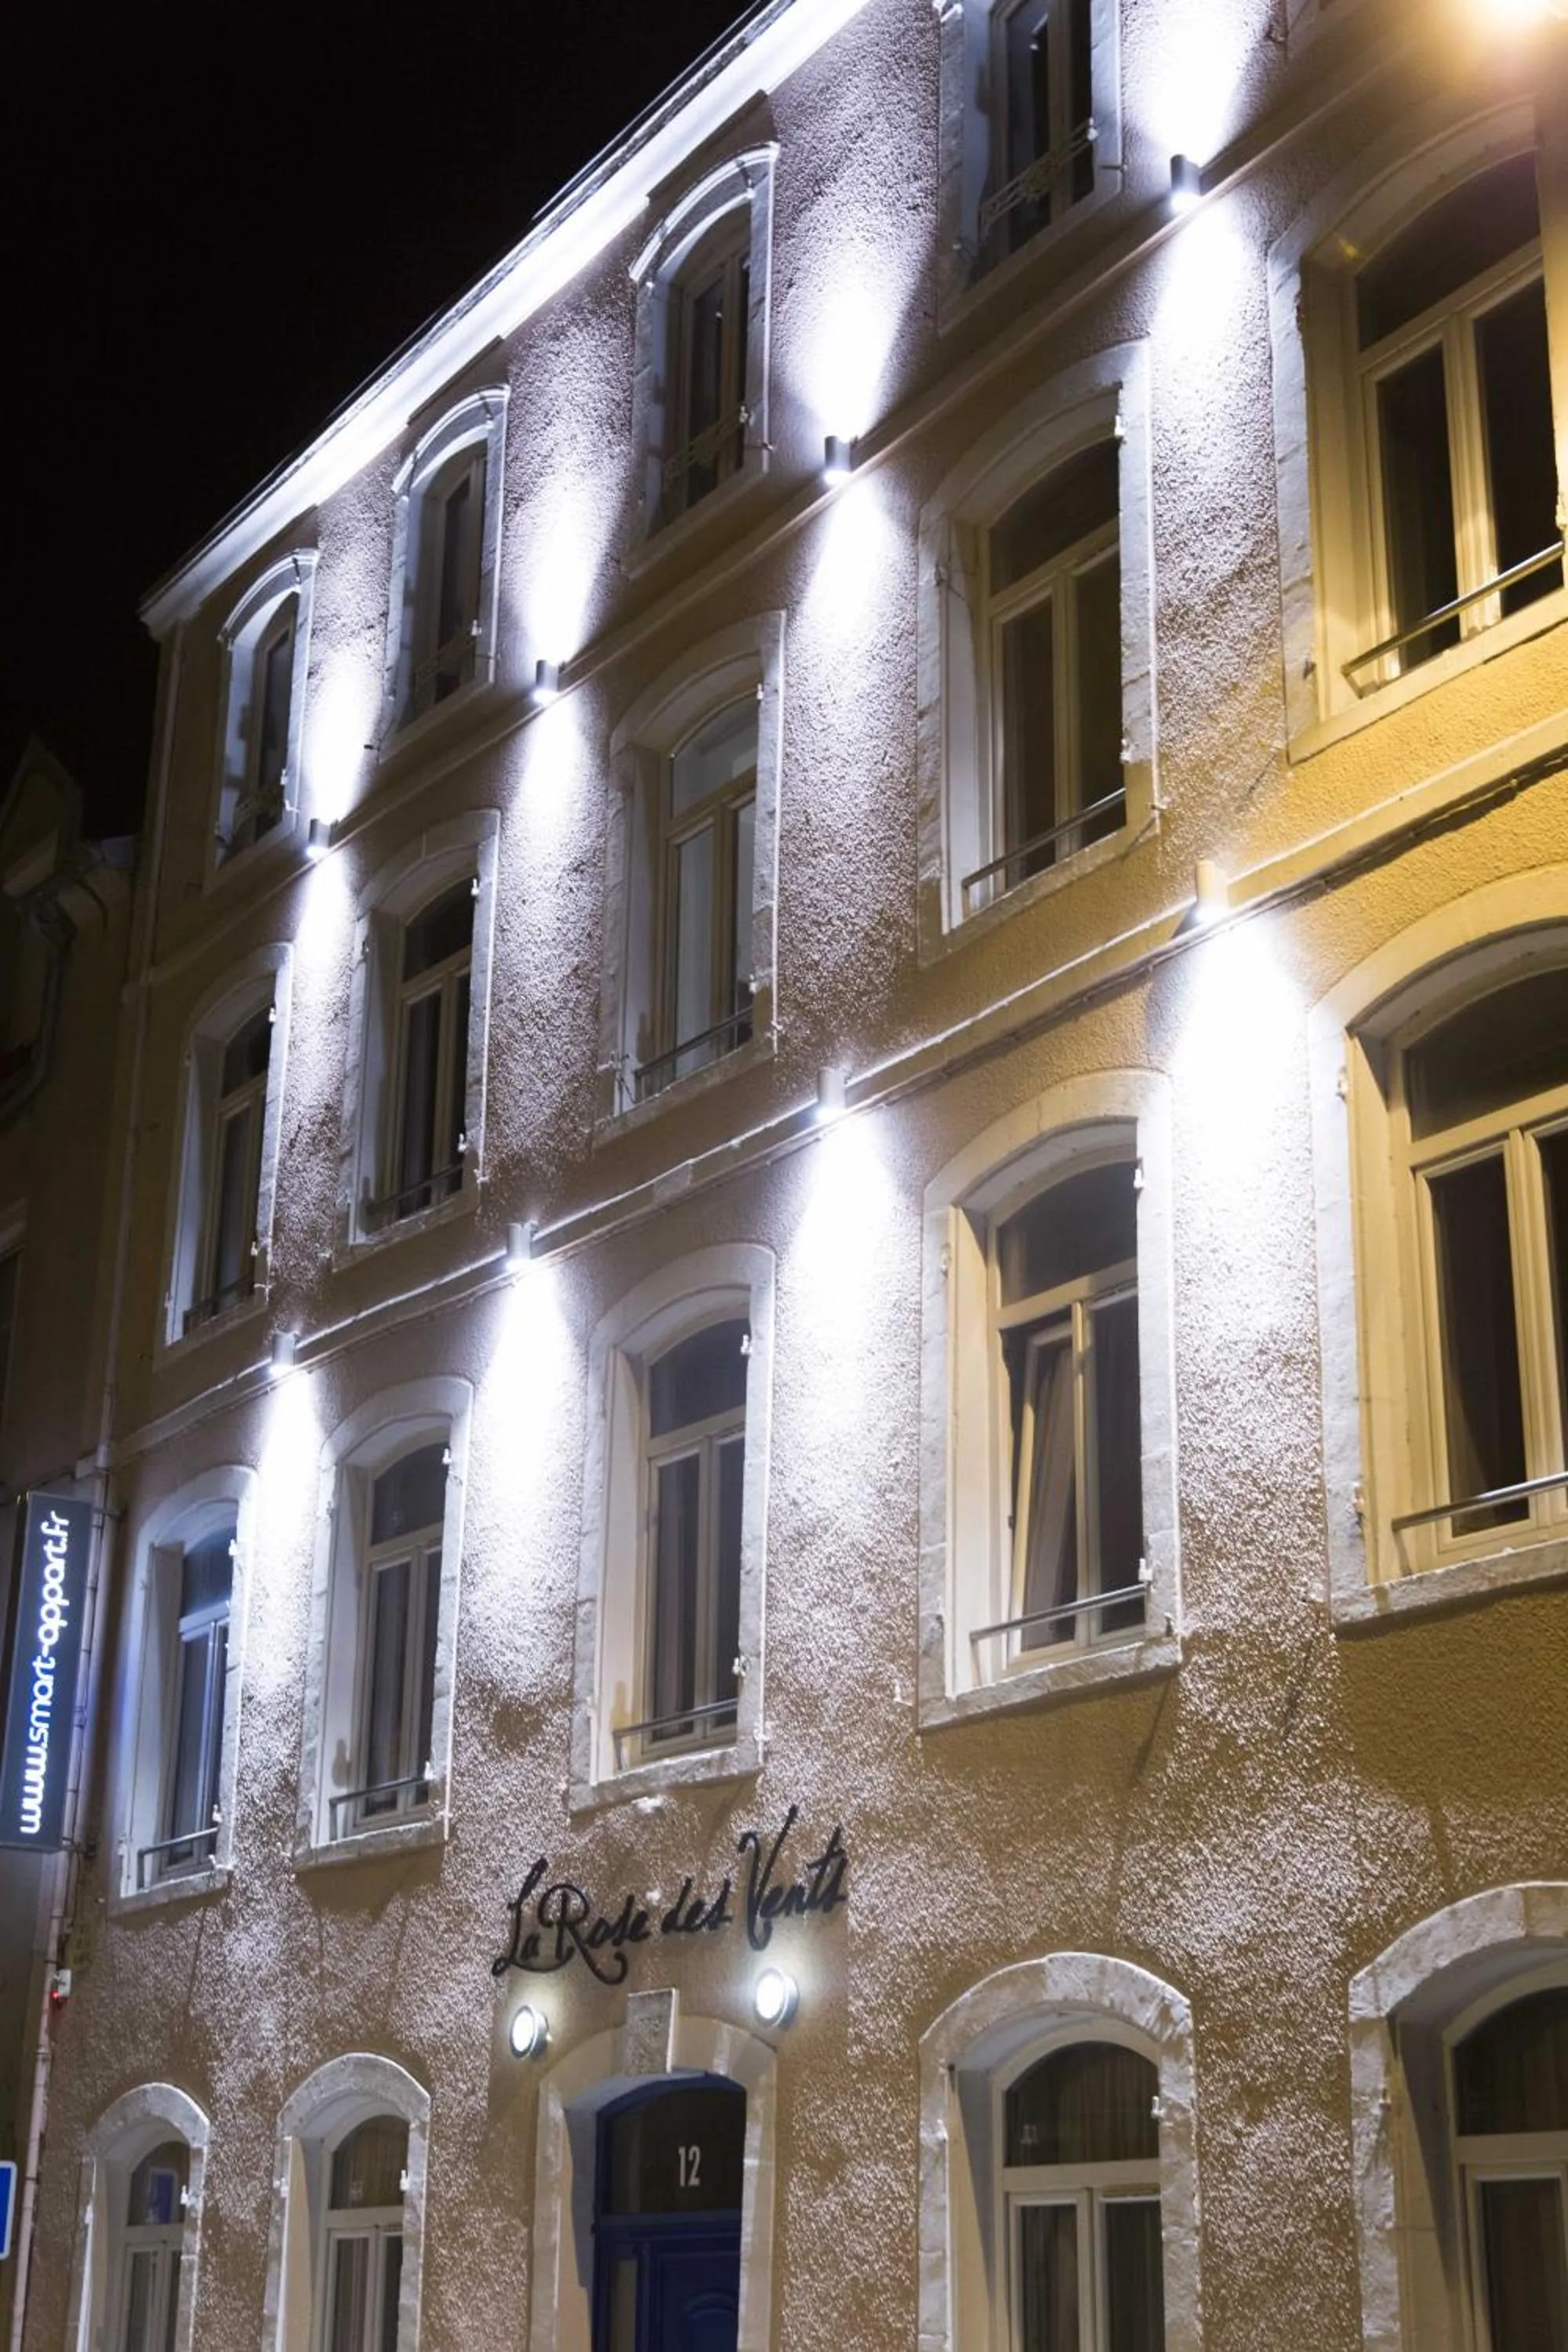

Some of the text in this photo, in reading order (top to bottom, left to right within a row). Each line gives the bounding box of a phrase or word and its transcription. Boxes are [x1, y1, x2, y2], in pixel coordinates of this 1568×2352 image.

[20, 1510, 71, 1835] www.smart-appart.fr
[492, 1804, 848, 1985] La Rose des Vents
[677, 2144, 701, 2187] 12
